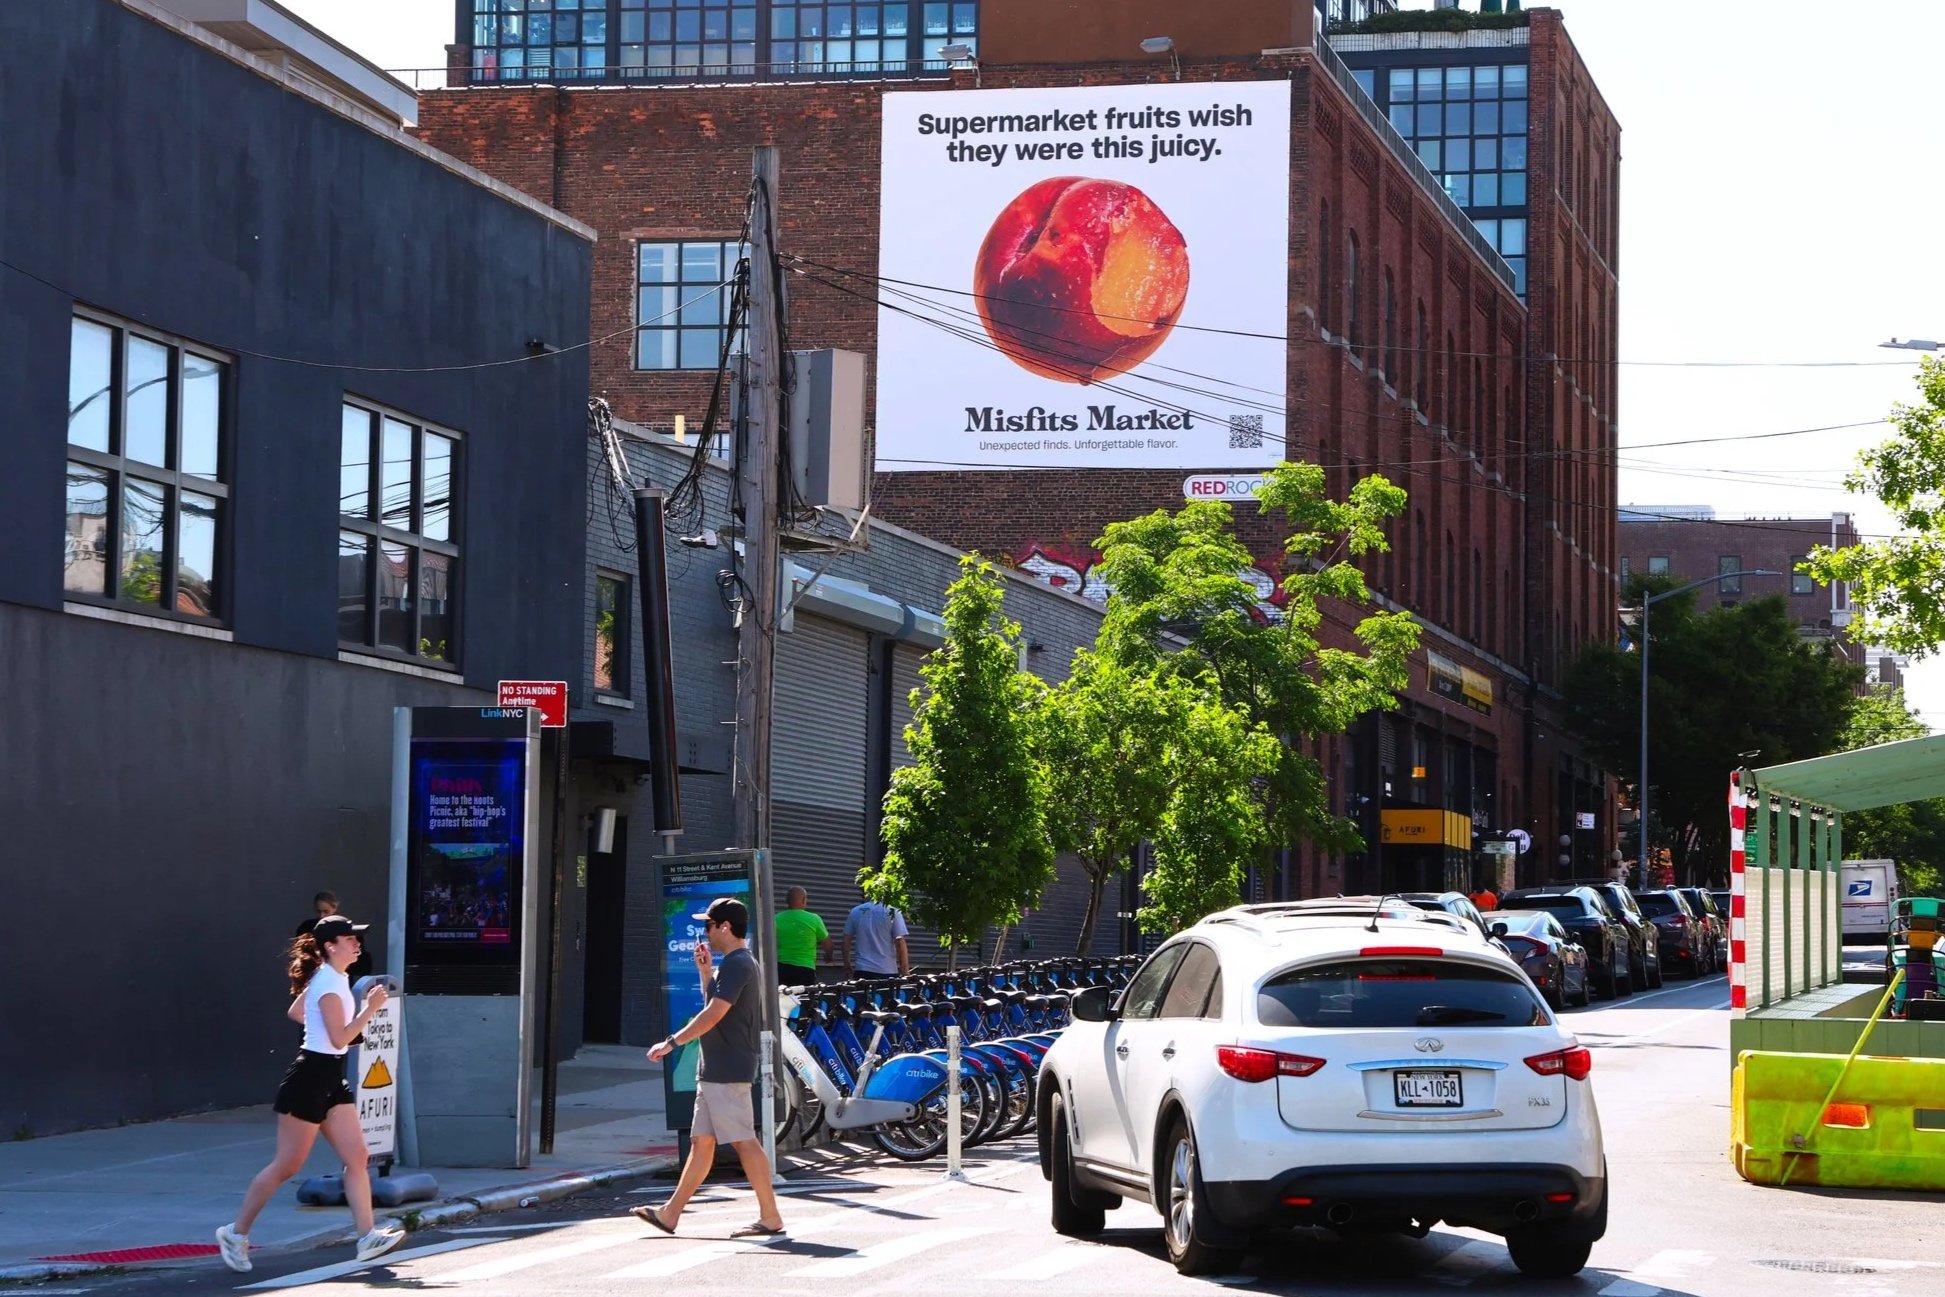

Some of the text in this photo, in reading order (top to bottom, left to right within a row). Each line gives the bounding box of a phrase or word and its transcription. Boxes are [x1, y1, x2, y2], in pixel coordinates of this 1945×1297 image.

[918, 103, 1252, 139] Supermarket fruits wish
[946, 133, 1222, 167] they were this juicy.
[964, 405, 1194, 432] Misfits Market
[979, 438, 1179, 452] Unexpected finds. Unforgettable flavor.
[502, 686, 557, 695] NO STANDING
[502, 697, 536, 706] Anytime
[481, 708, 523, 718] LinkNYC
[430, 794, 450, 805] Home
[451, 795, 459, 805] to
[460, 794, 473, 805] the
[455, 806, 468, 816] aka
[429, 817, 460, 830] greatest
[720, 862, 742, 870] Avenue
[671, 875, 708, 883] Williamsburg
[373, 1008, 389, 1018] rom
[360, 1096, 393, 1120] AFURI
